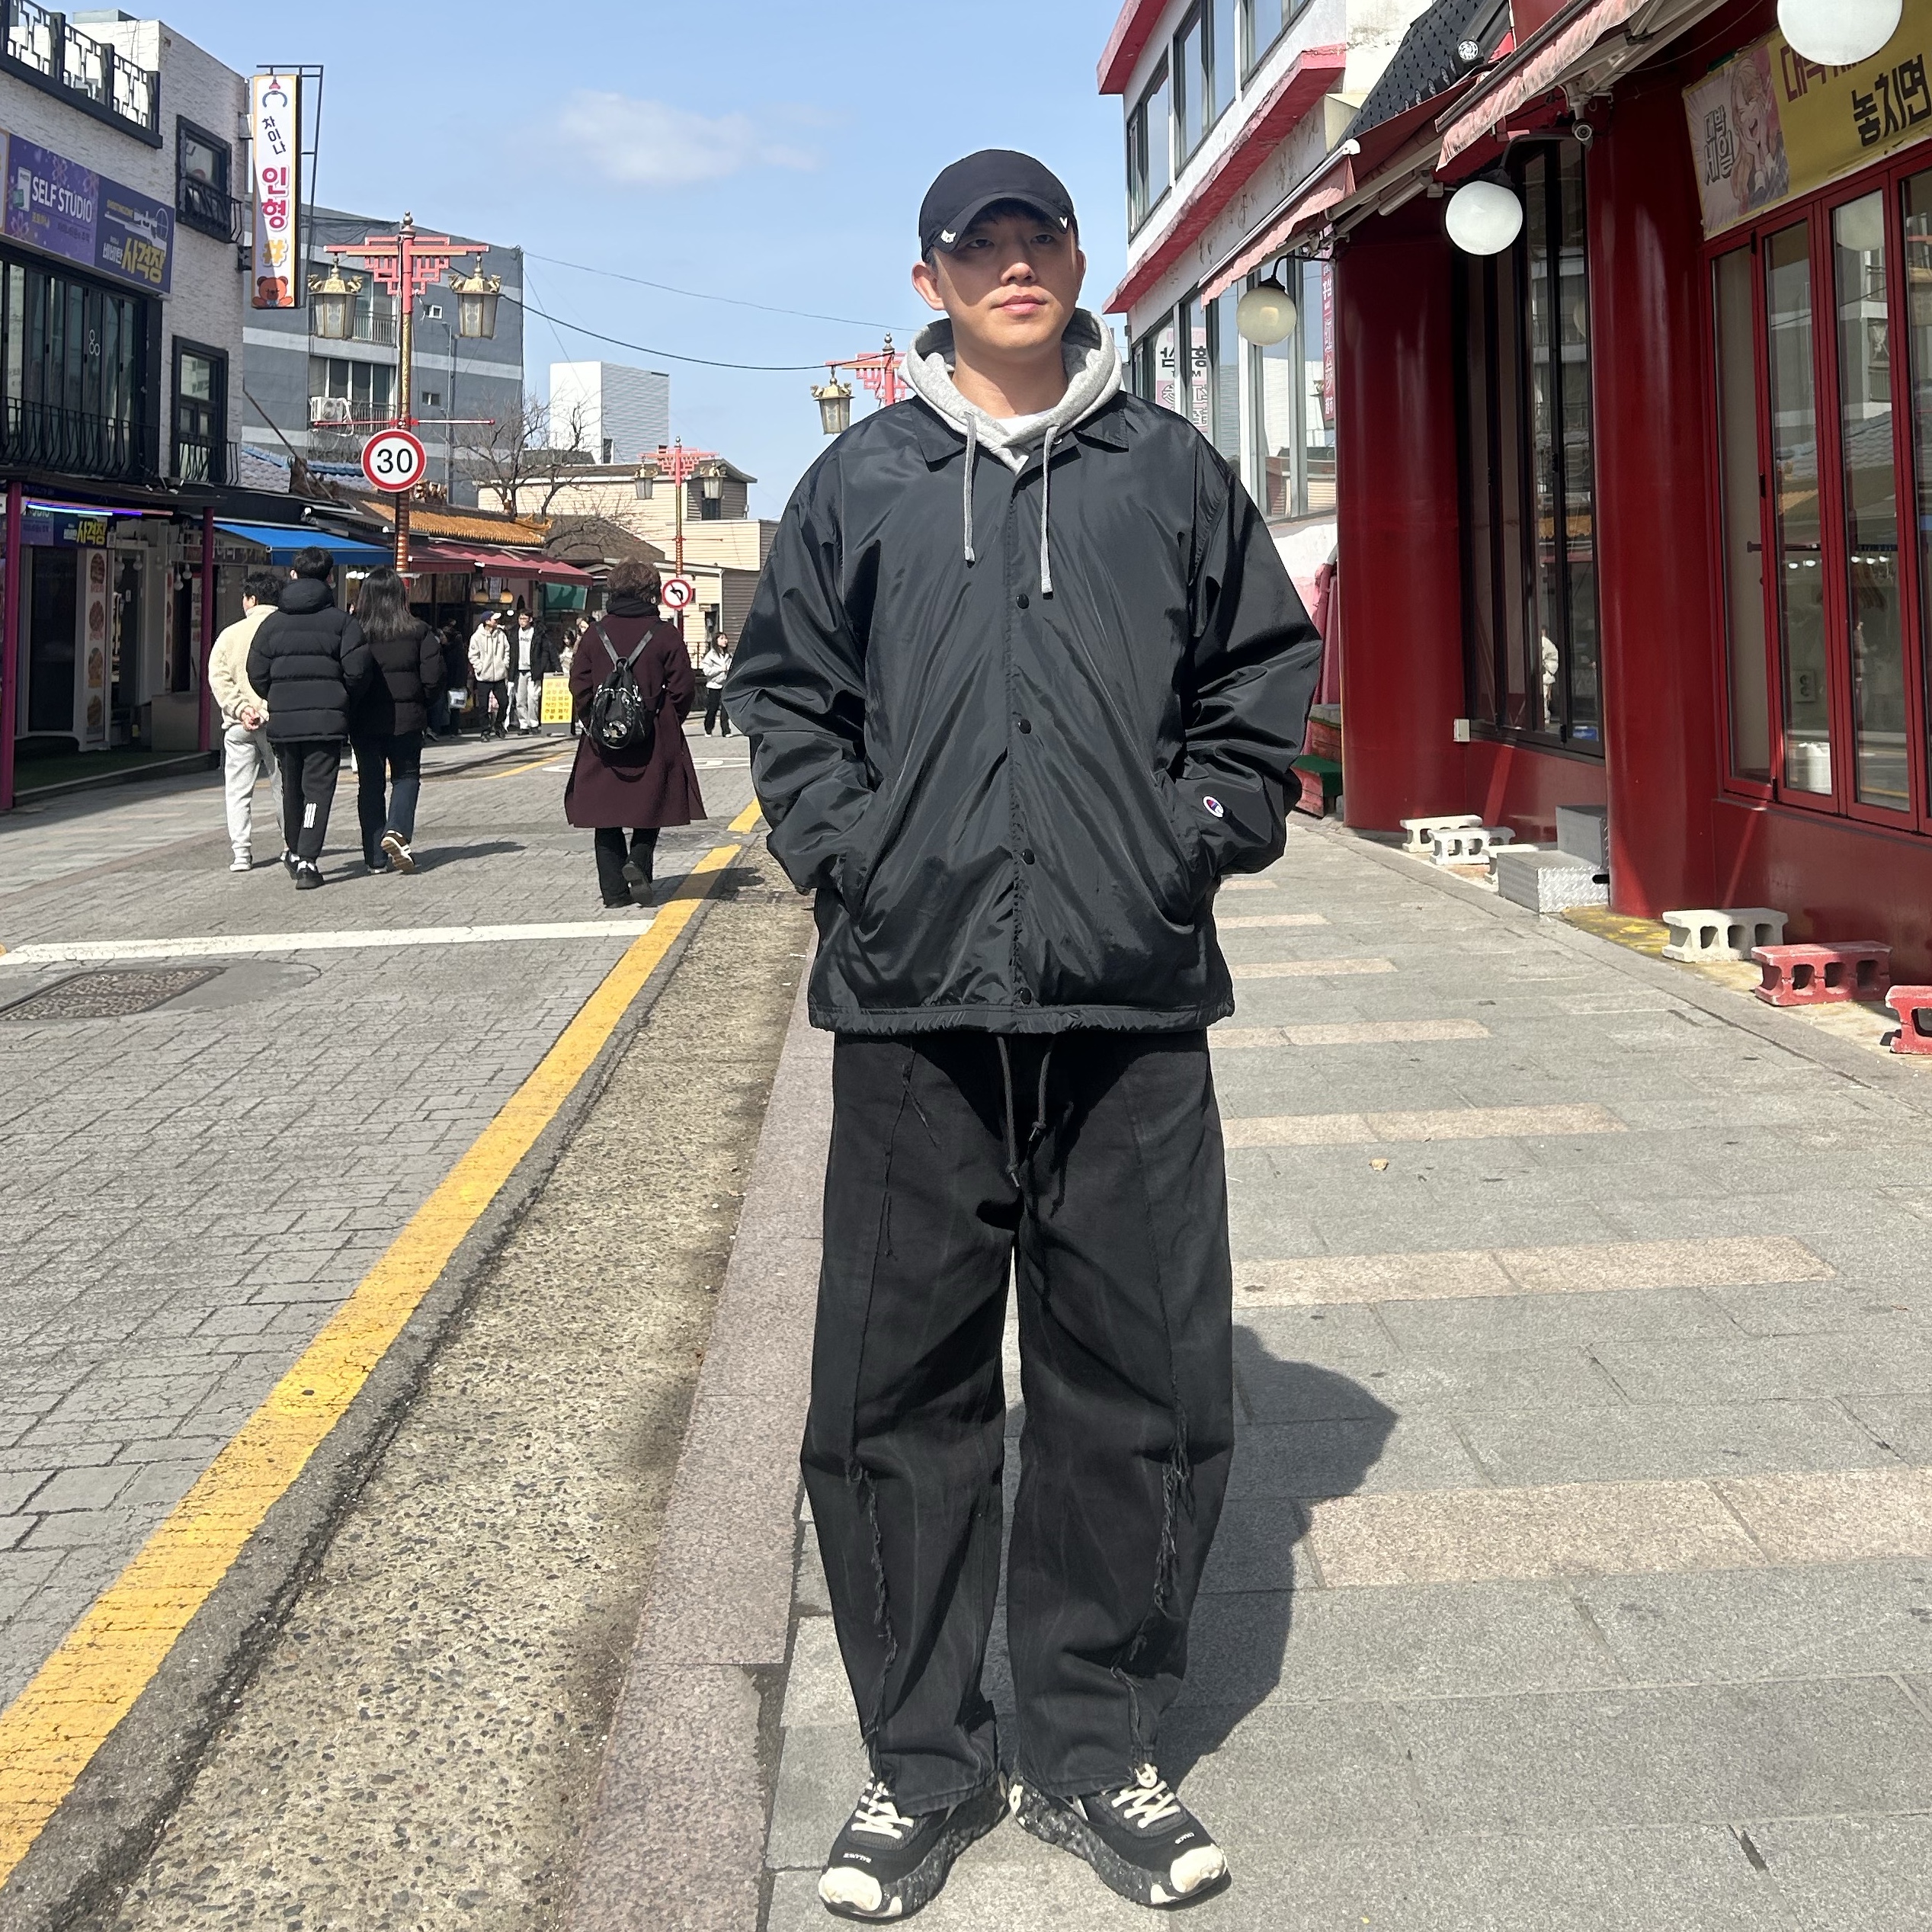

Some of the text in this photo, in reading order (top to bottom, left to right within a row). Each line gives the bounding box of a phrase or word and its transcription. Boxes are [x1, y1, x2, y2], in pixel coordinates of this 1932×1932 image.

[1851, 53, 1931, 146] 놓치면
[261, 116, 287, 155] 차이나
[32, 176, 56, 207] SELF
[58, 187, 92, 223] STUDIO
[262, 167, 287, 229] 인형
[121, 237, 165, 284] 사격장
[376, 448, 413, 474] 30
[77, 521, 106, 545] 사격장
